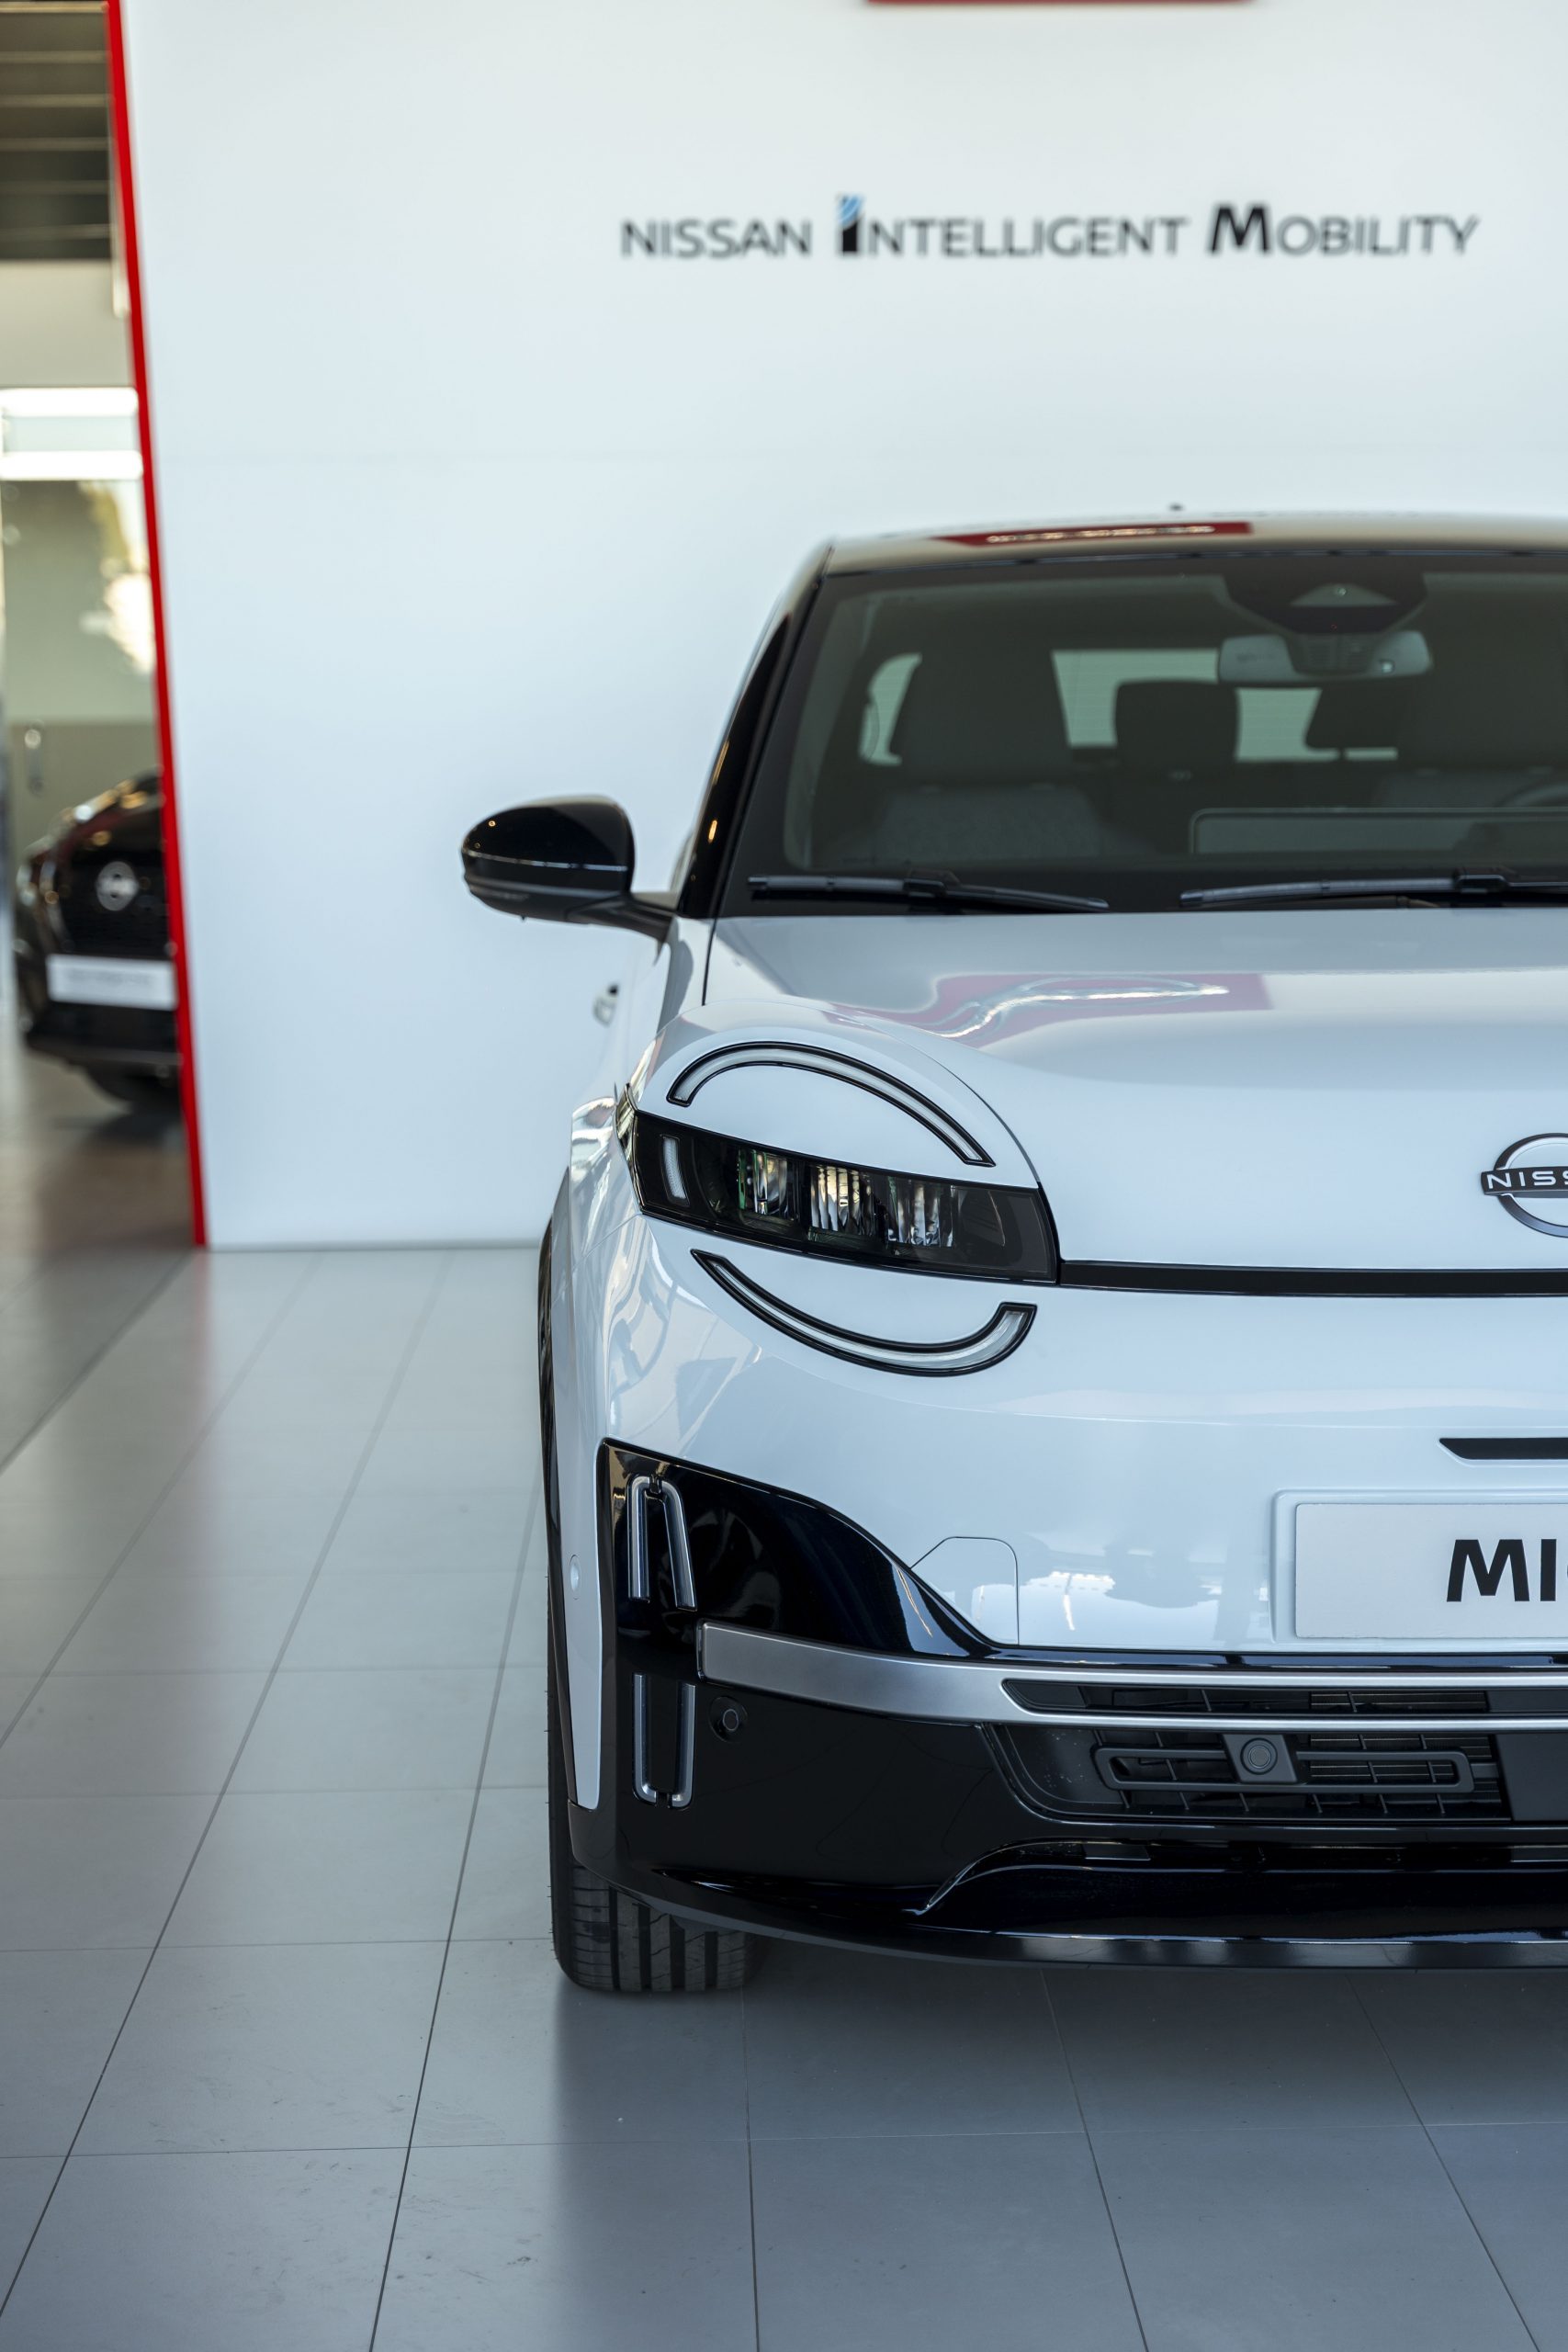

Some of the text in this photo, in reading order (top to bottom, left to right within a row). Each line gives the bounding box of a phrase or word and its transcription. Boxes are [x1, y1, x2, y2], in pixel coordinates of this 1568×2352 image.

[620, 194, 1480, 258] NISSAN INTELLIGENT MOBILITY
[1486, 1170, 1568, 1189] NIS
[1447, 1539, 1568, 1602] MI
